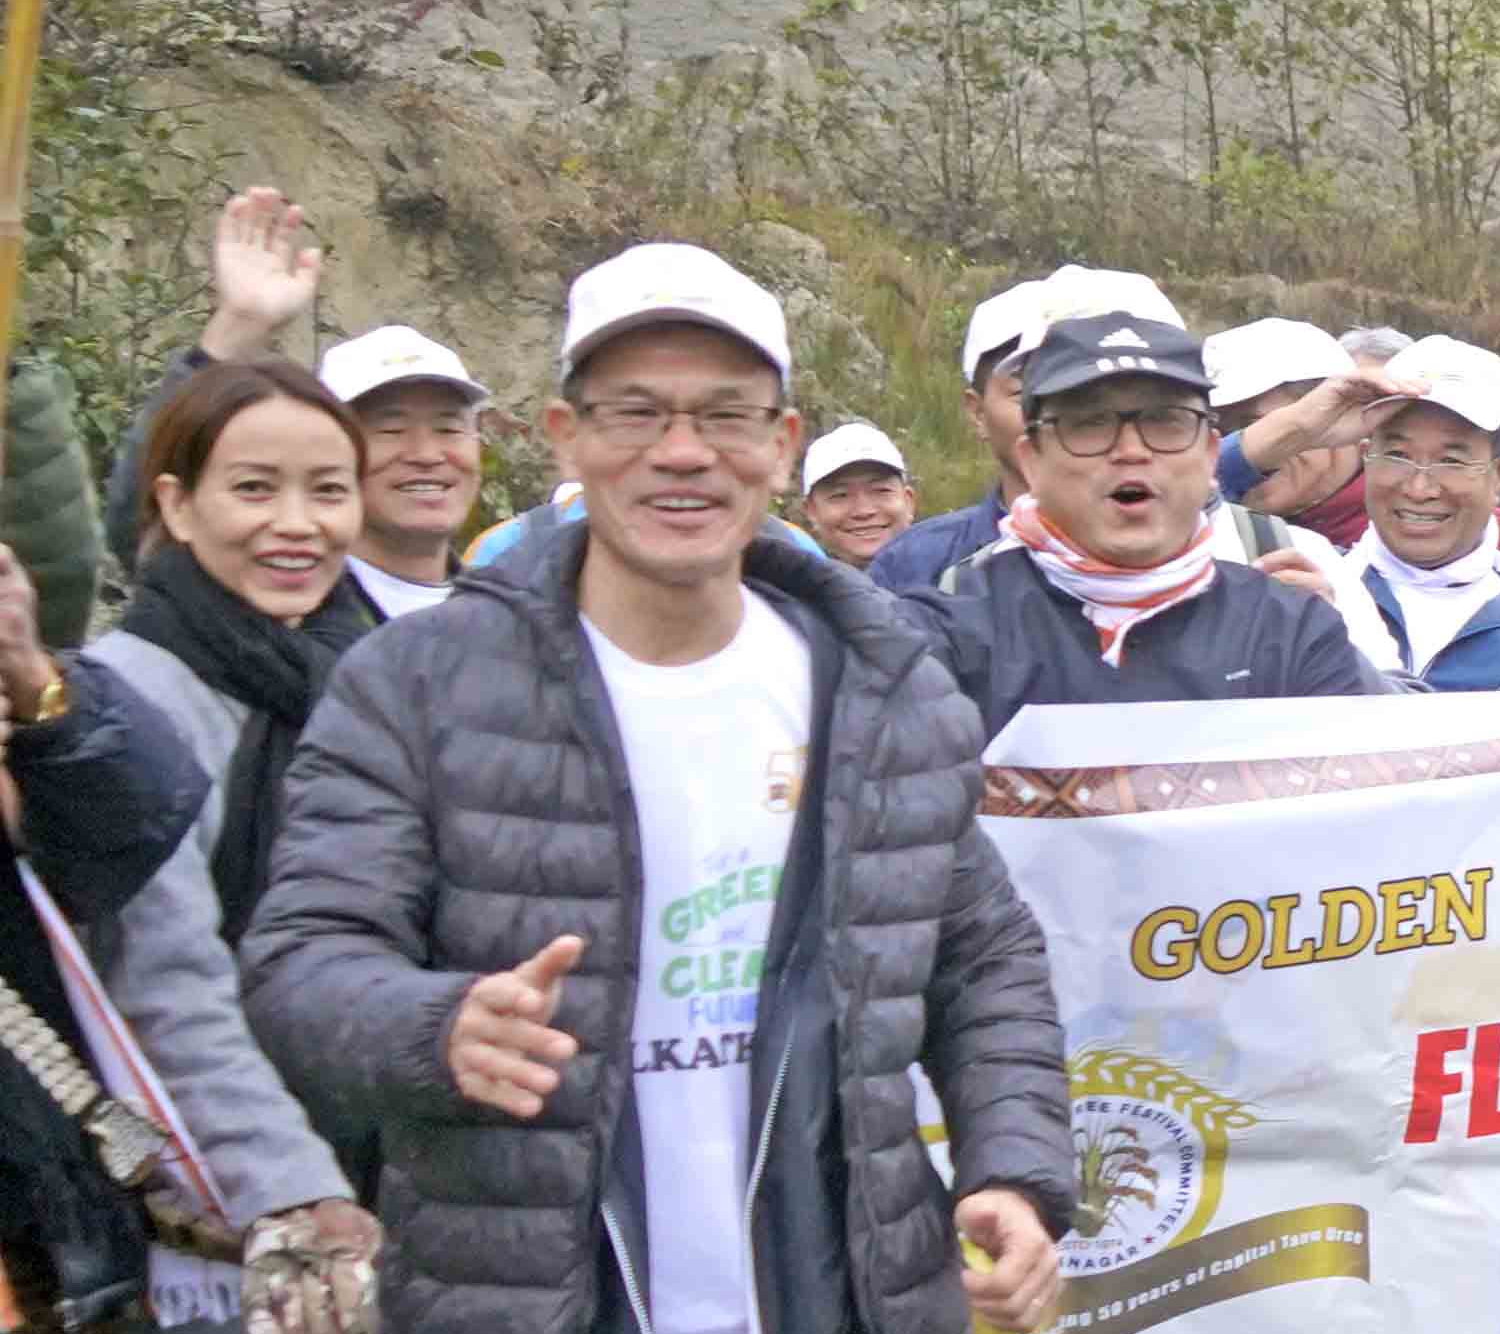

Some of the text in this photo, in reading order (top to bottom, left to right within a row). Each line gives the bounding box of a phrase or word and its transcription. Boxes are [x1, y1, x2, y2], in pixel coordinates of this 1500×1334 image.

[1130, 868, 1493, 981] GOLDEN
[1119, 1103, 1188, 1142] FESTIVAL
[1059, 1245, 1139, 1269] NAGAR
